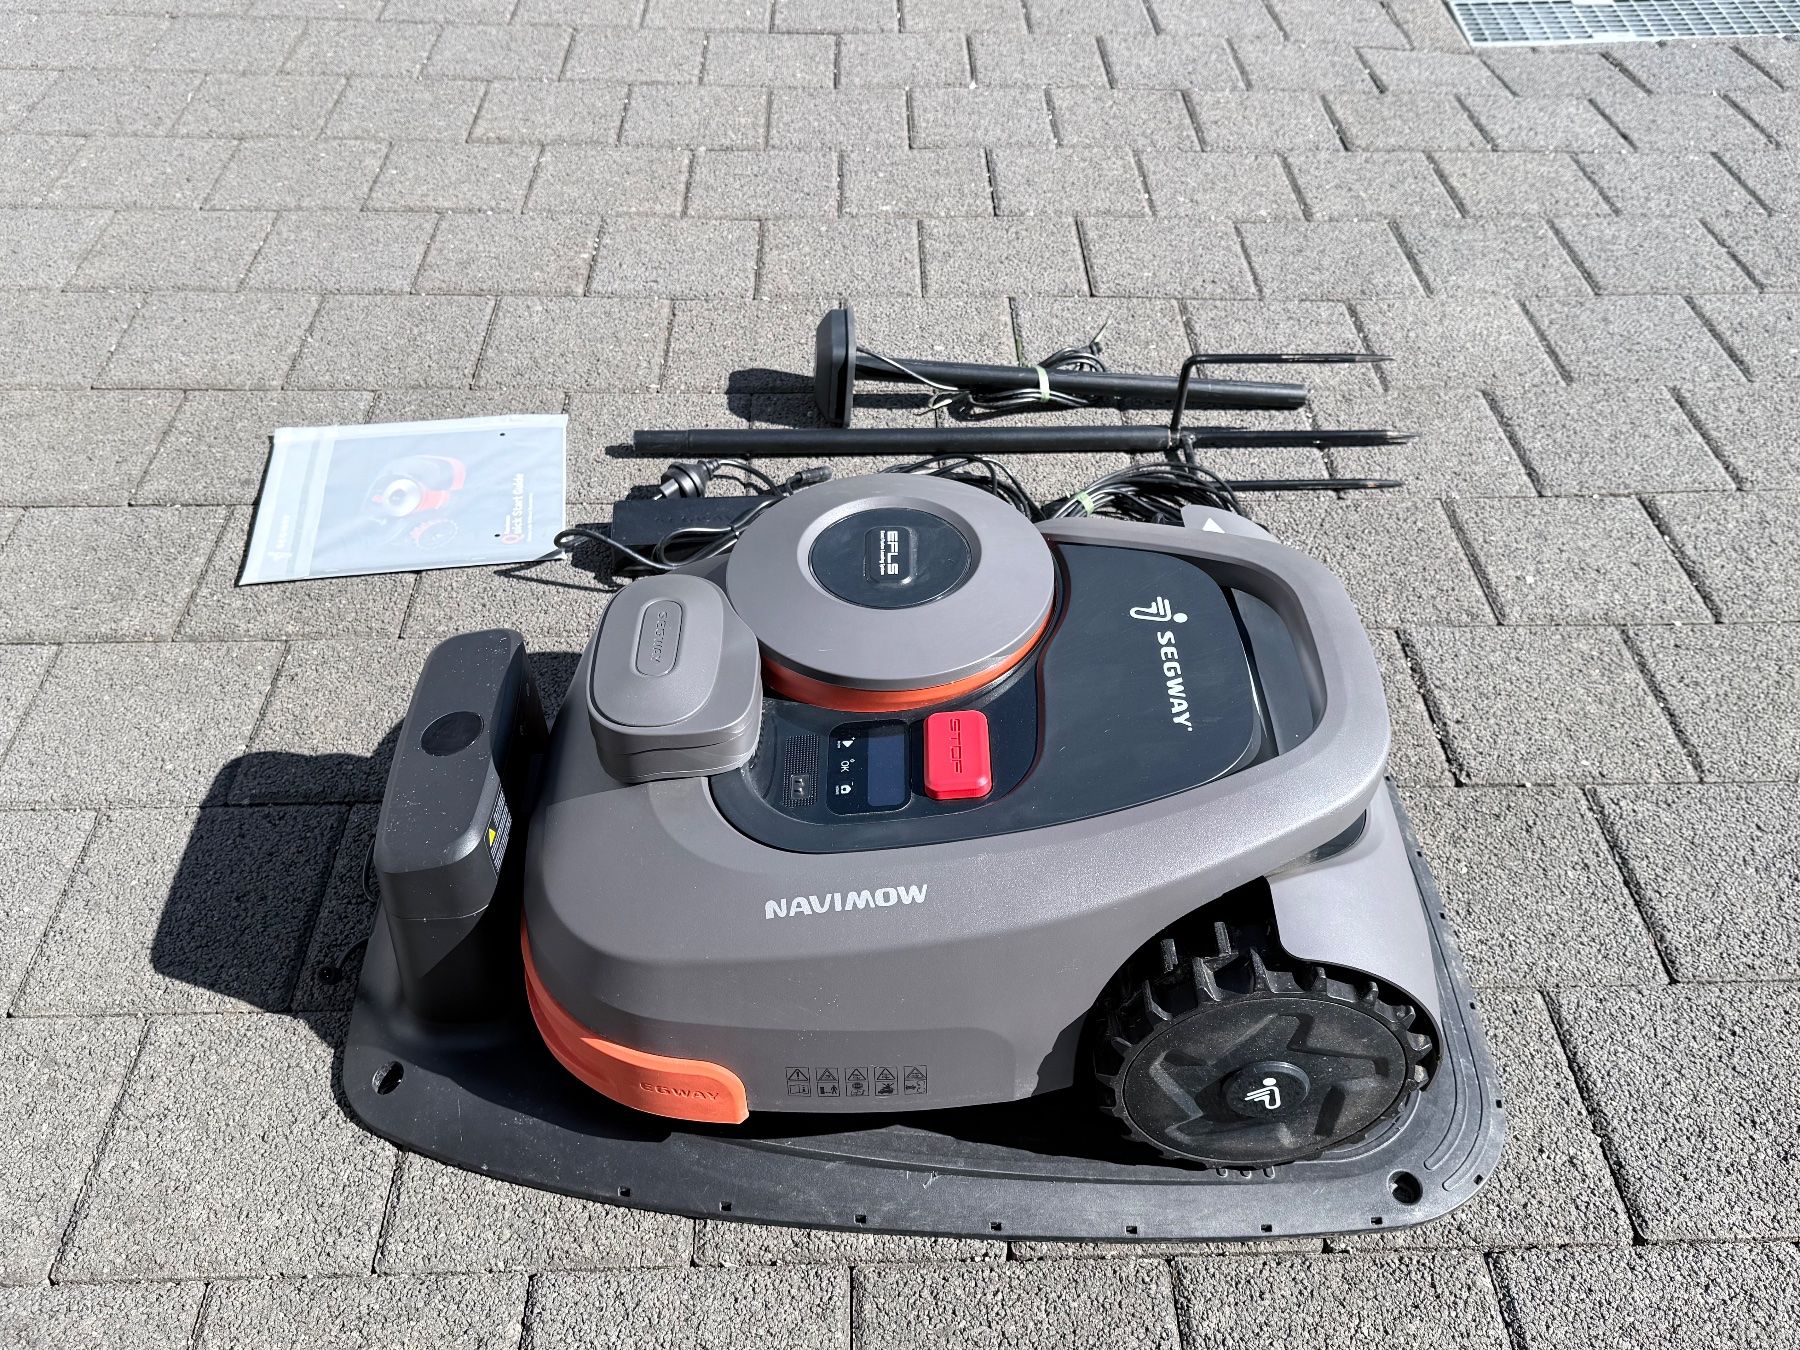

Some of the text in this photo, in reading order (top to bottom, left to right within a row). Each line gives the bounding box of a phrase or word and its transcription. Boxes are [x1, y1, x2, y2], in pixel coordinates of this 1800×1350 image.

[513, 473, 524, 495] Guide
[512, 496, 523, 516] Start
[501, 517, 524, 544] Quick
[887, 530, 899, 575] EFLS
[651, 611, 668, 663] SEGWAY
[1156, 630, 1192, 727] SEGWAY
[949, 718, 963, 774] STOP
[840, 760, 850, 773] OK
[764, 883, 928, 920] NAVIMOW
[632, 1081, 719, 1100] EGWAY
